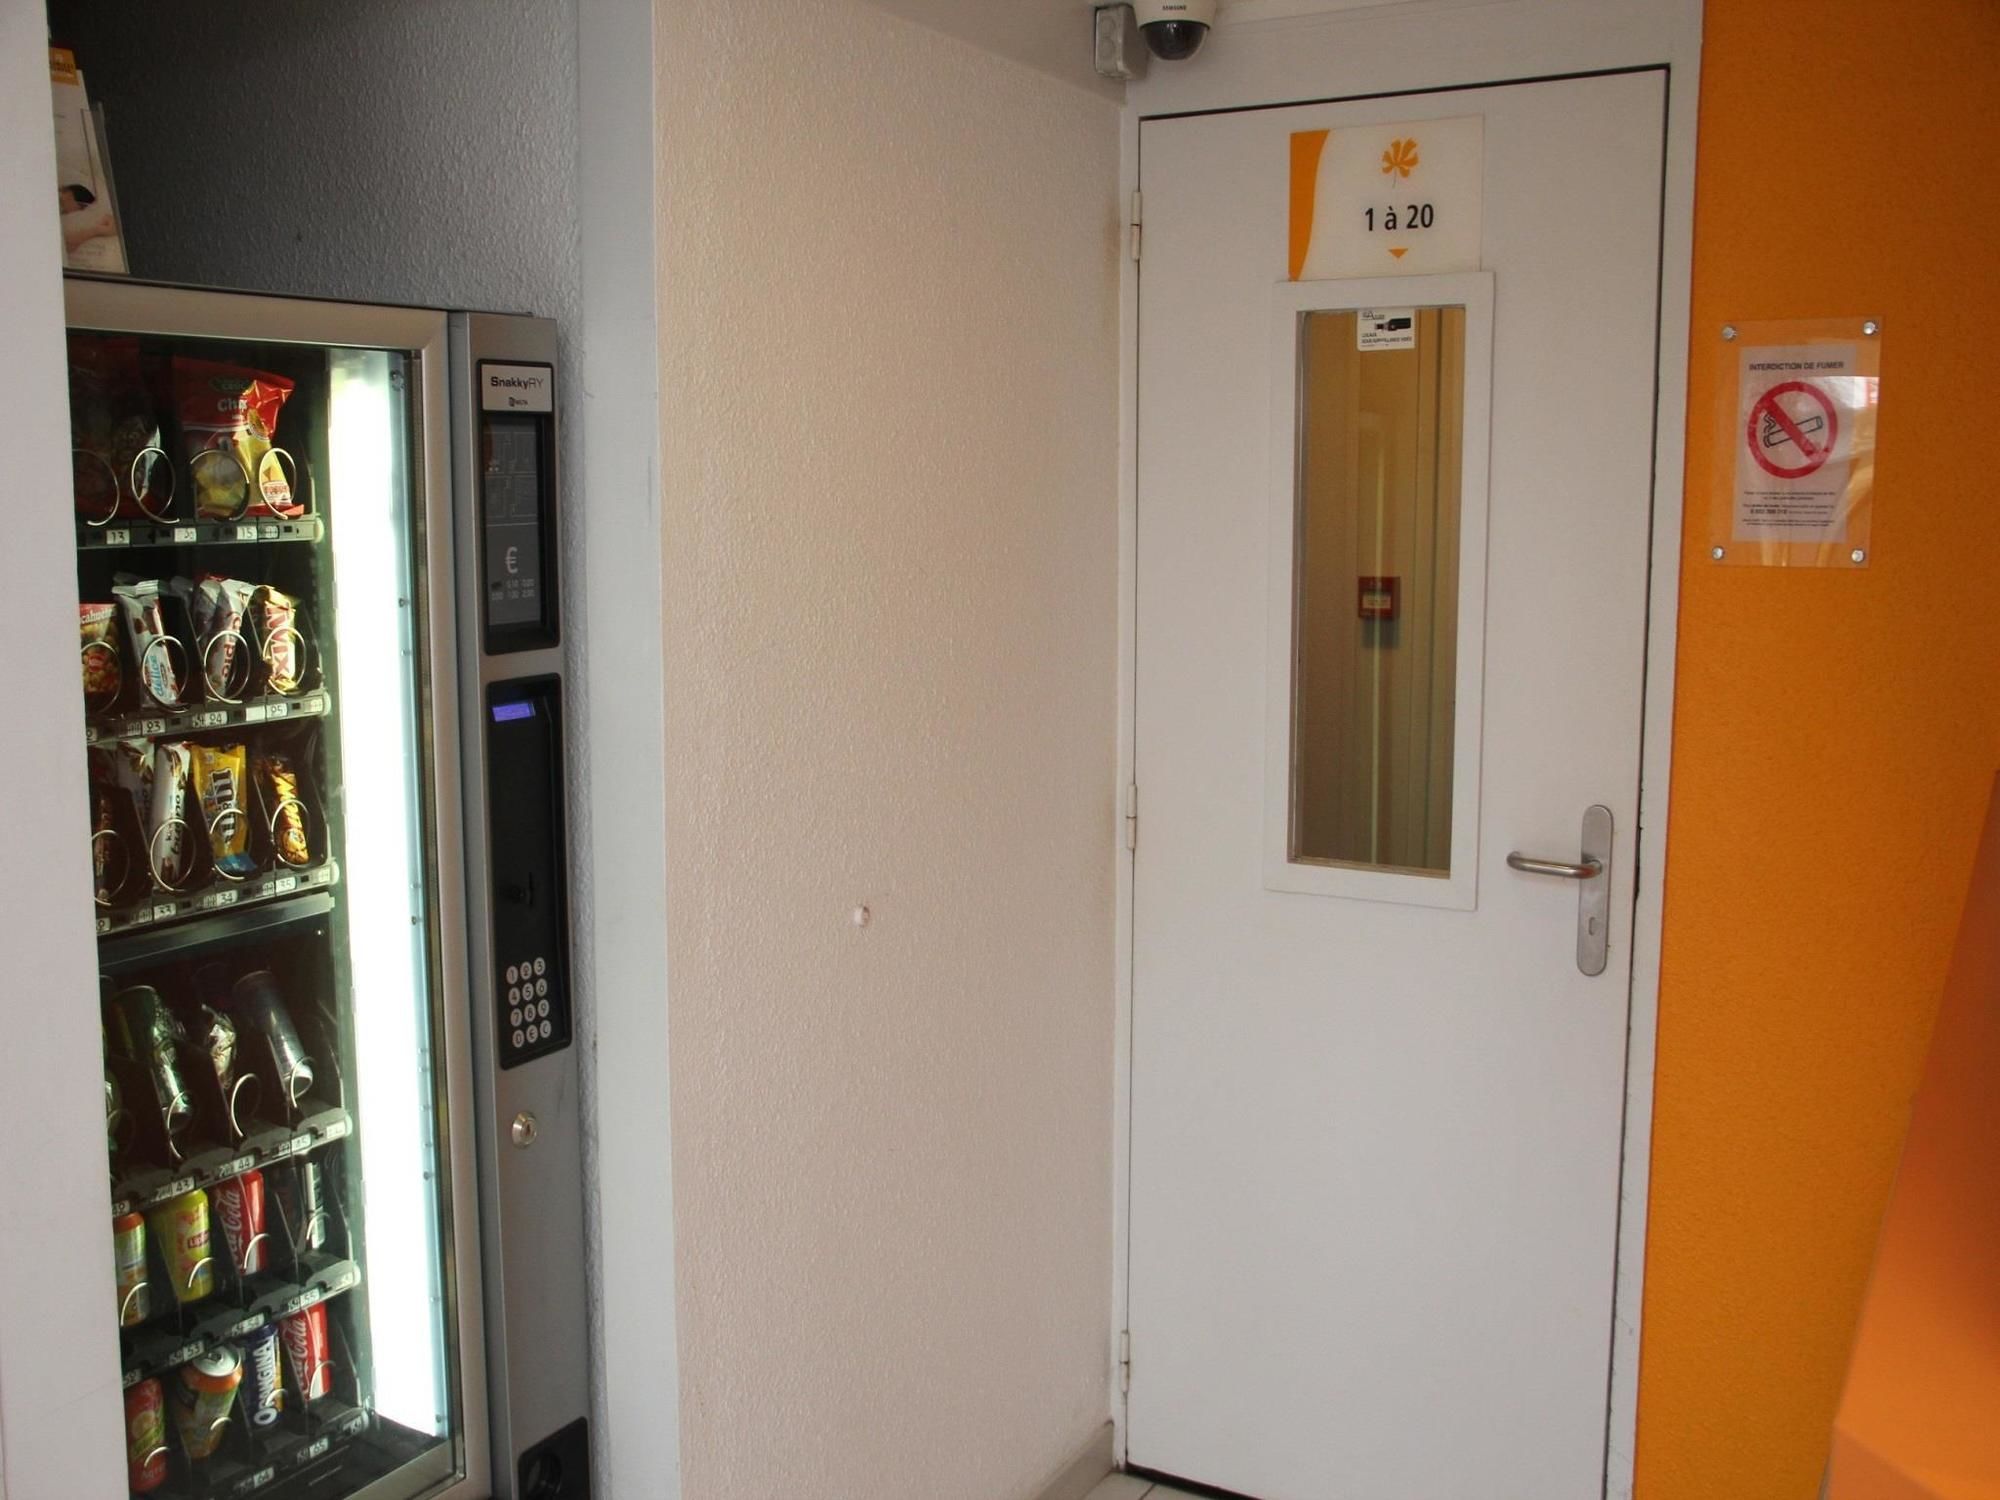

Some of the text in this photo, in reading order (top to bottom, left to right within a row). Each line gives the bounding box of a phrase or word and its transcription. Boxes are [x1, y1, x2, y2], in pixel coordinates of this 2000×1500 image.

[1364, 203, 1434, 232] 1 à 20
[1748, 360, 1845, 371] INTERDICTION DE FUMER
[505, 546, 519, 574] €
